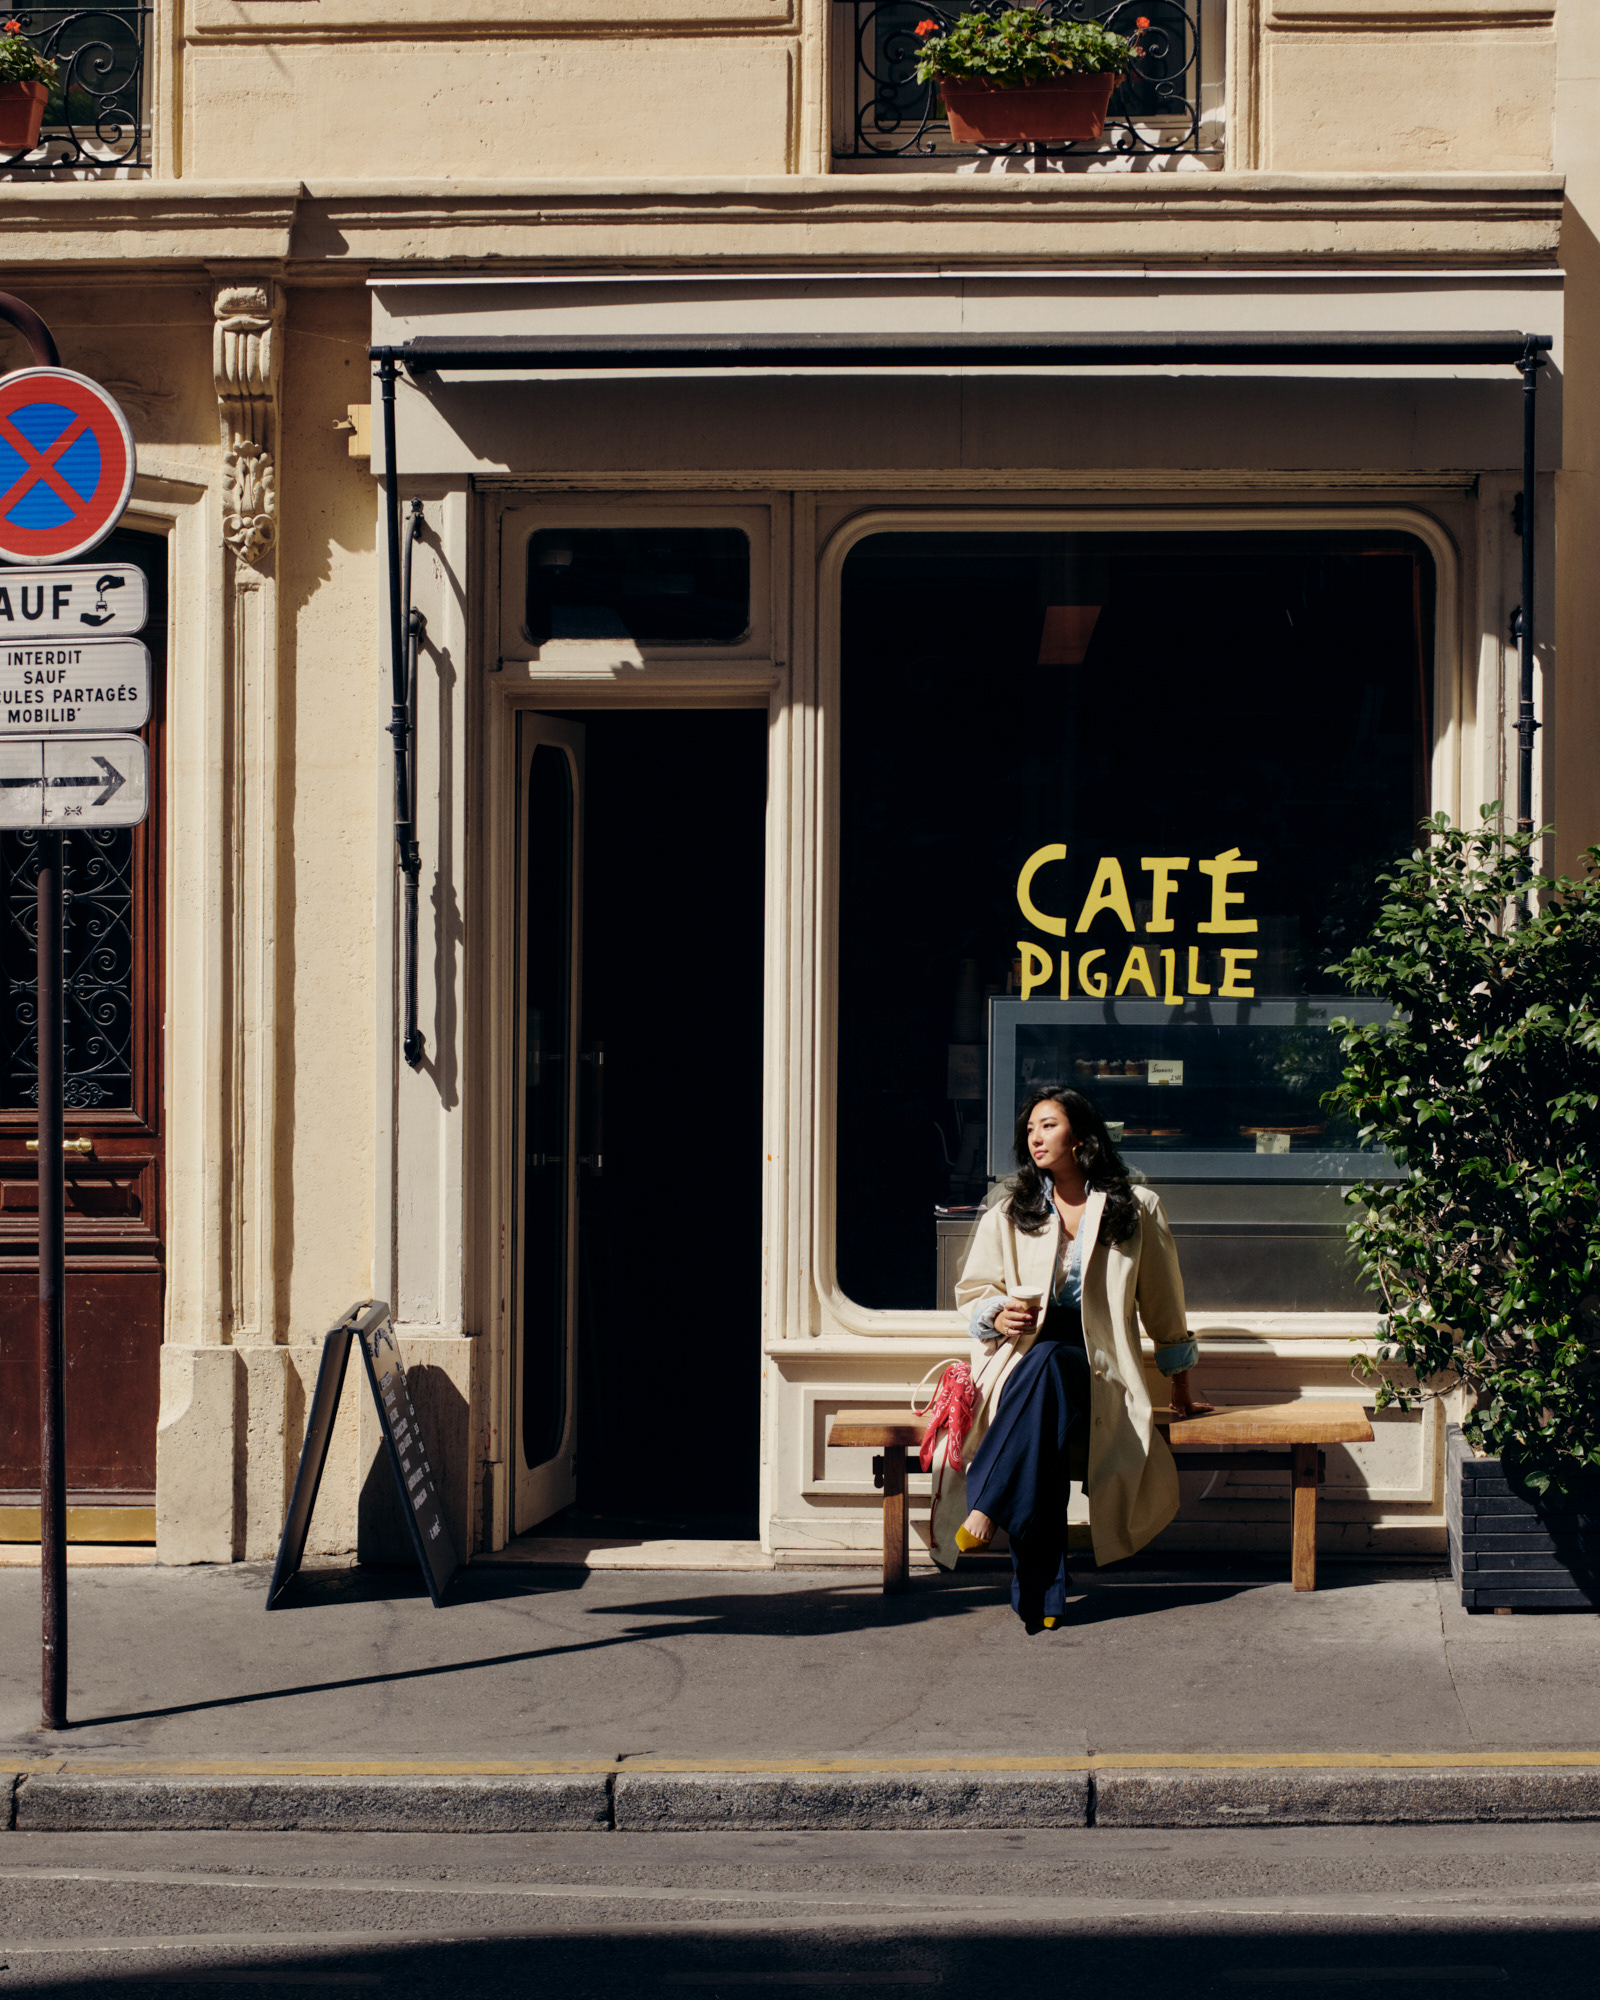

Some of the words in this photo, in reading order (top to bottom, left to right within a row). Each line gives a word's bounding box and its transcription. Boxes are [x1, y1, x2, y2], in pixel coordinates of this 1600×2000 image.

[8, 650, 82, 666] INTERDIT
[24, 669, 67, 685] SAUF
[0, 689, 44, 704] ULES
[53, 684, 138, 703] PARTAGÉS
[1016, 843, 1258, 937] CAFÉ
[1016, 940, 1258, 1005] PIGALLE
